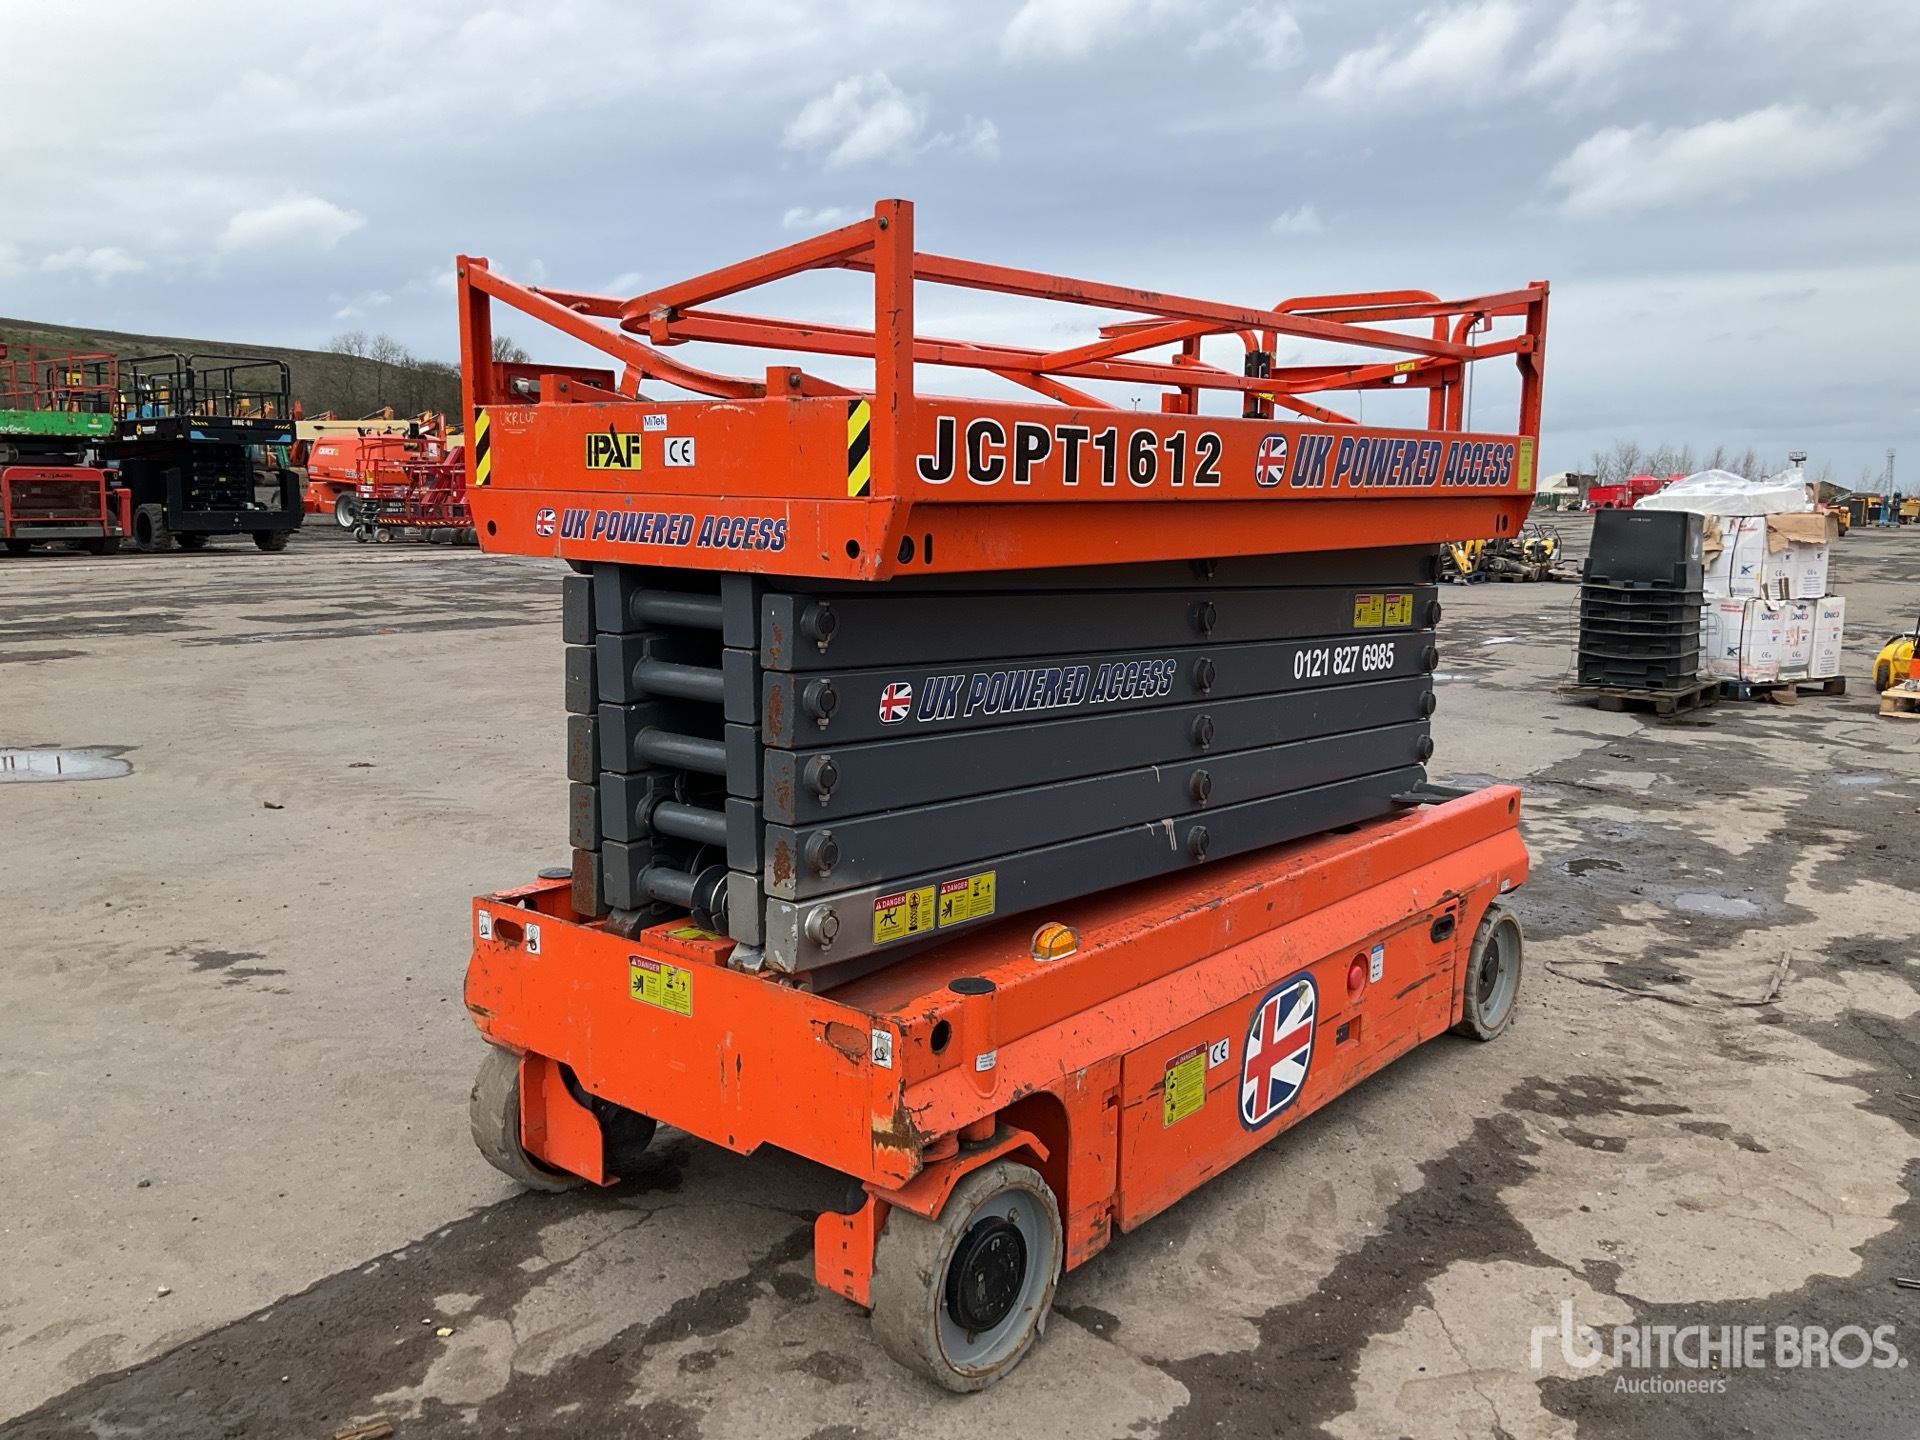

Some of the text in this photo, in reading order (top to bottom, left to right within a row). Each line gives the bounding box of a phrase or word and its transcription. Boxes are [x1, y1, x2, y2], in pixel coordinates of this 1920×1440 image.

[644, 416, 666, 427] MiTek
[586, 422, 641, 468] IPAF
[668, 439, 691, 464] CE
[917, 416, 1223, 487] JCPT1612
[1290, 434, 1514, 489] UK POWERED ACCESS
[561, 508, 788, 552] UK POWERED ACCESS
[1293, 642, 1395, 680] 0121 827 6985
[917, 658, 1176, 722] UK POWERED ACCESS
[946, 880, 968, 892] DANGER
[882, 895, 906, 909] DANGER
[637, 959, 660, 973] DANGER
[1180, 1049, 1197, 1062] DANGER
[1212, 1040, 1227, 1064] CE
